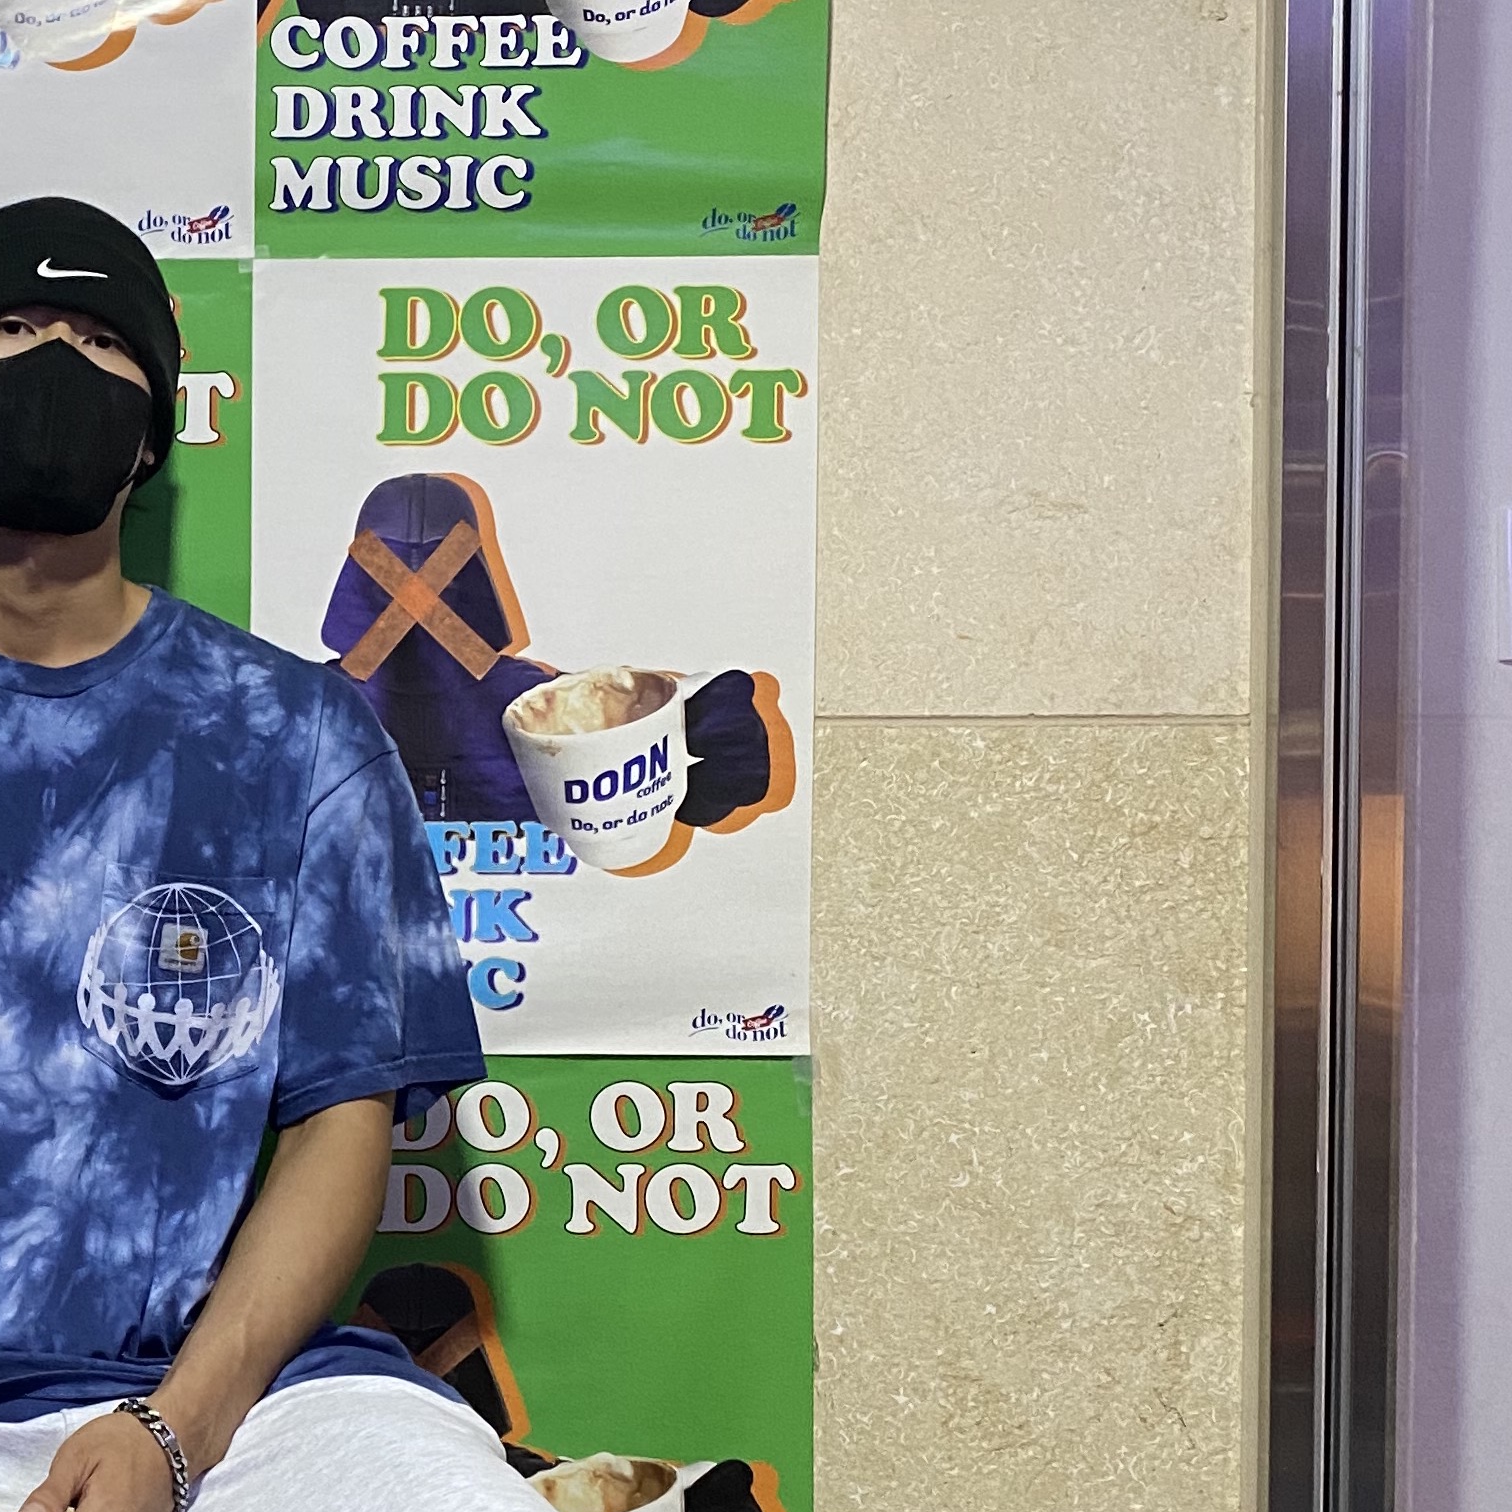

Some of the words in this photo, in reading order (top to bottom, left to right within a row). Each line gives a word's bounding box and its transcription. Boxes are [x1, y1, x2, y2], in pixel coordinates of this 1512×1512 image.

[582, 9, 611, 25] Do,
[615, 9, 636, 21] or
[640, 0, 661, 16] do
[269, 14, 588, 70] COFFEE
[270, 84, 547, 140] DRINK
[268, 154, 534, 212] MUSIC
[171, 227, 192, 244] do
[197, 222, 232, 244] not
[376, 285, 572, 377] DO,
[596, 284, 757, 362] OR
[376, 370, 542, 446] DO
[568, 368, 808, 445] NOT
[564, 734, 668, 804] DODN
[637, 772, 672, 798] coffee
[571, 818, 599, 834] Do,
[603, 819, 623, 830] or
[627, 810, 647, 826] do
[651, 795, 674, 817] not
[726, 1025, 747, 1041] do
[753, 1021, 787, 1042] not
[589, 1080, 746, 1153] OR
[376, 1162, 533, 1235] DO
[563, 1163, 800, 1236] NOT
